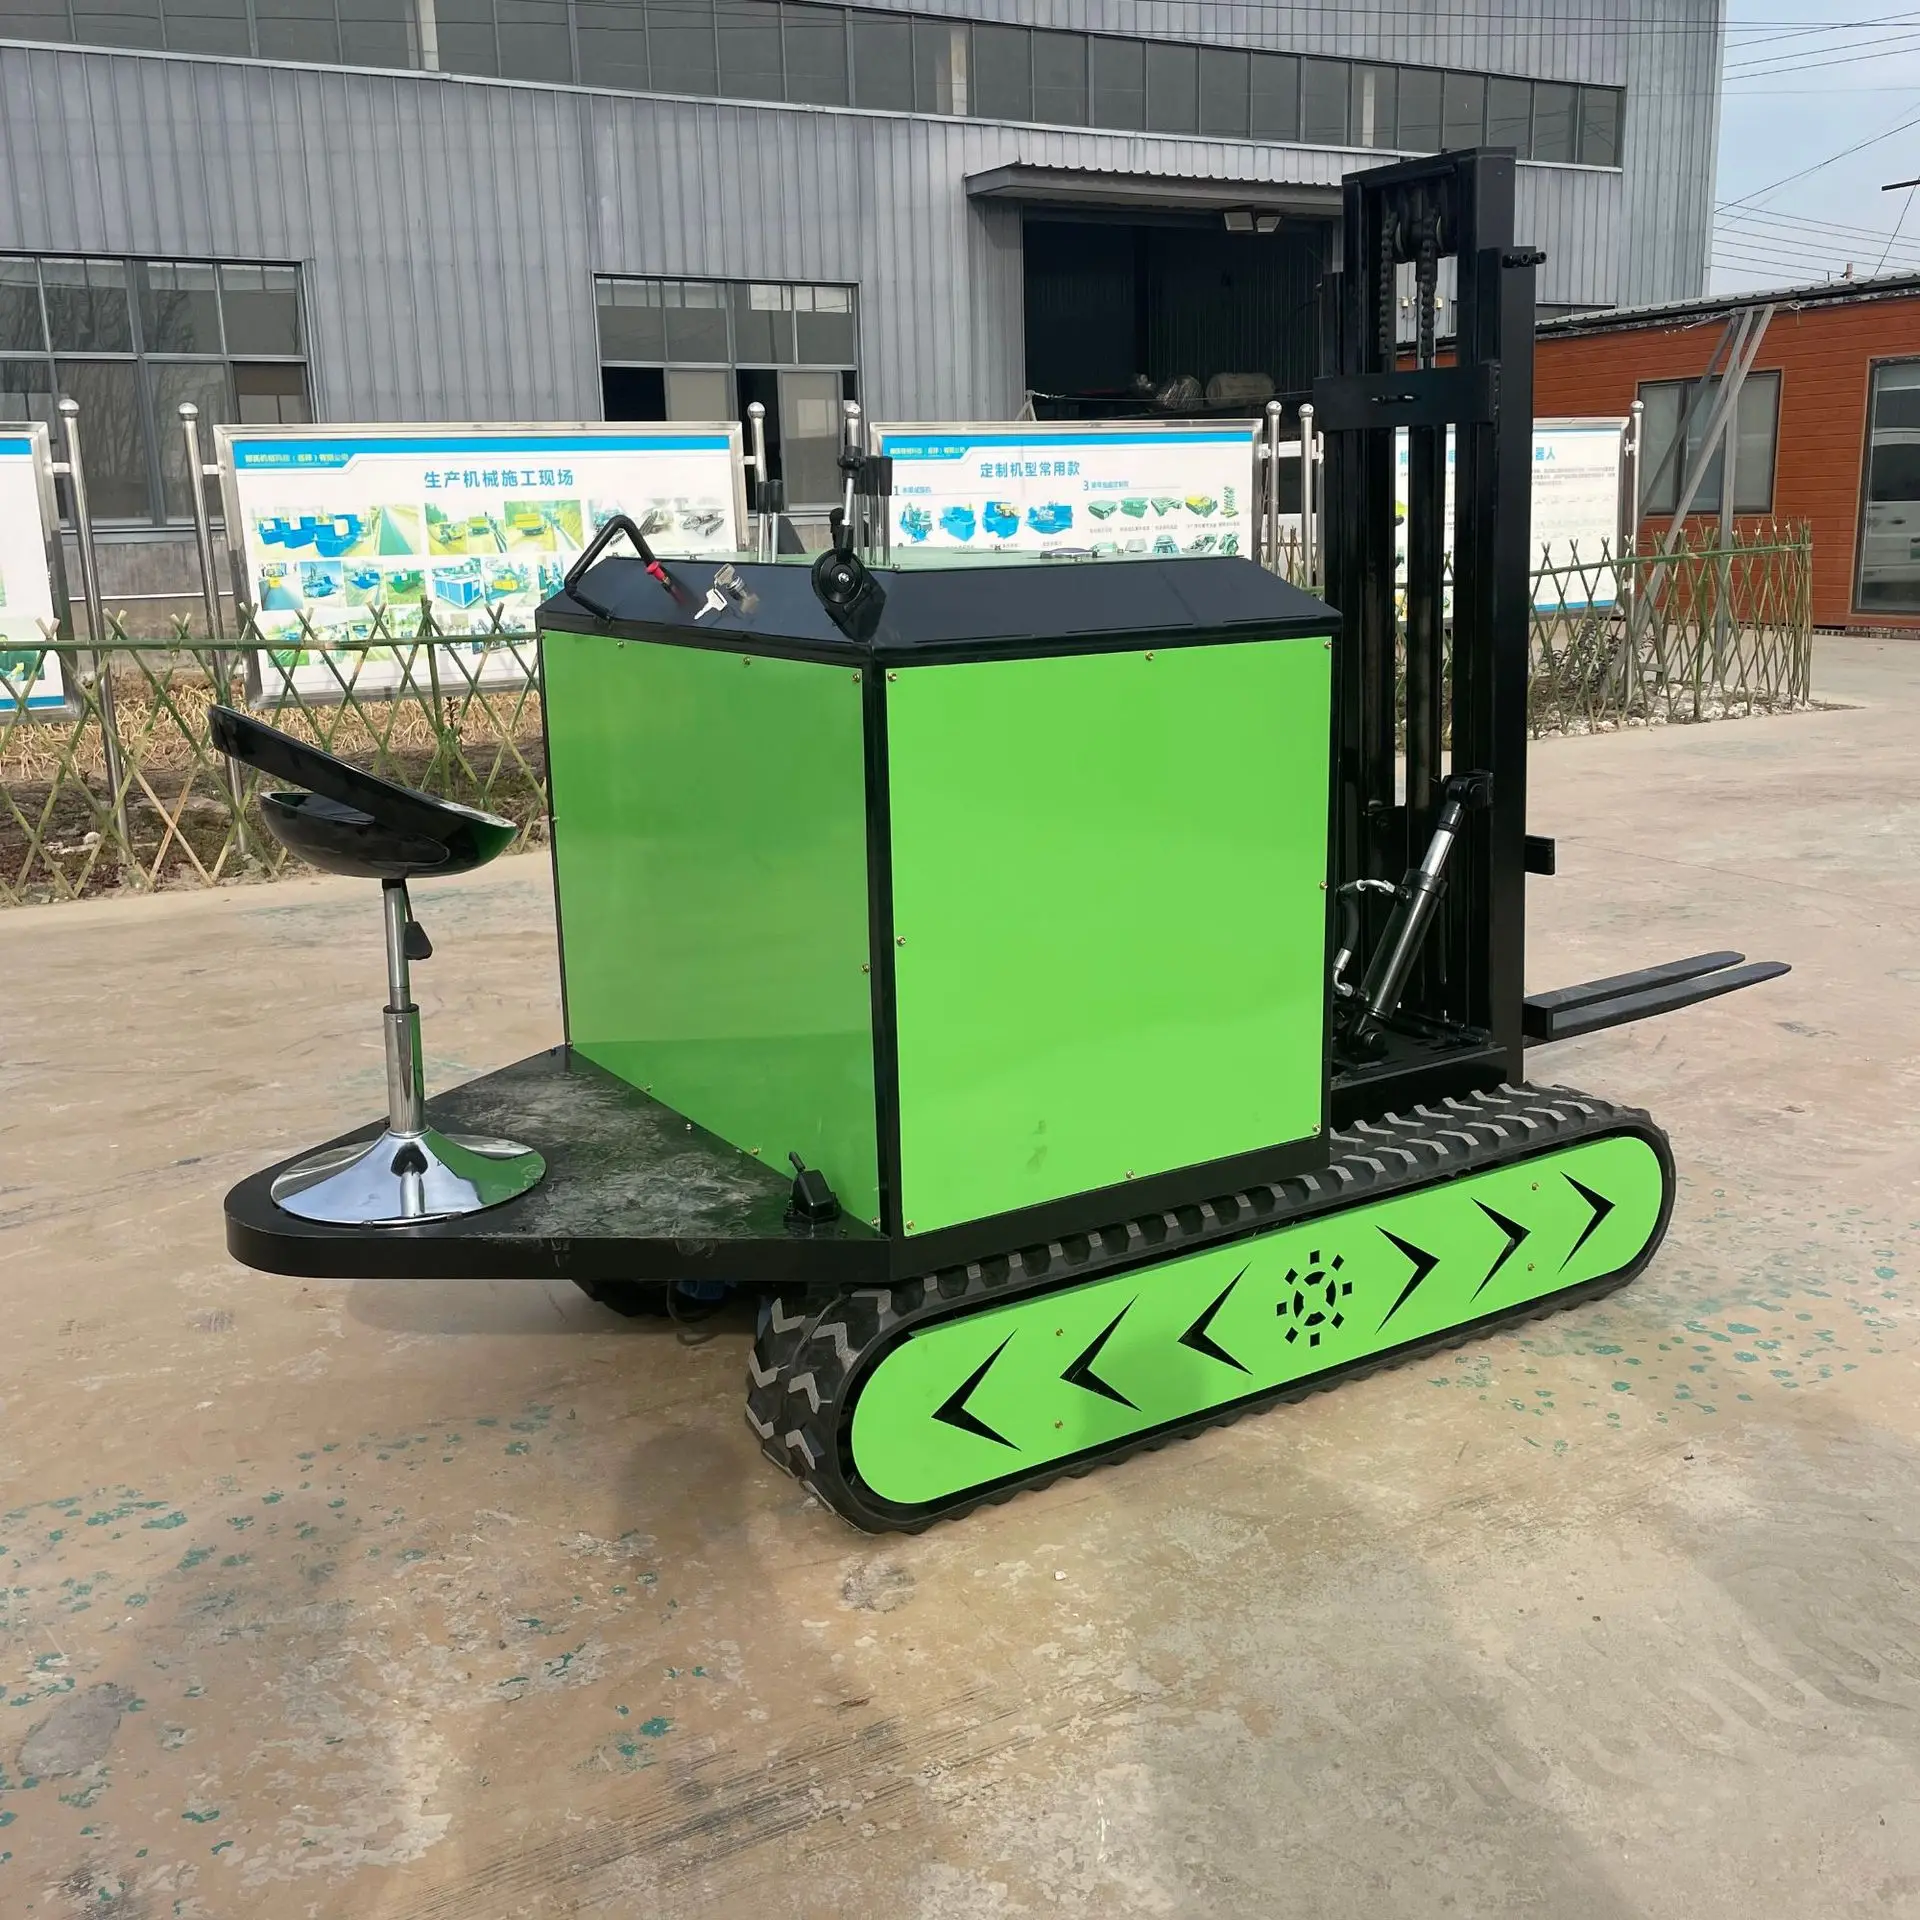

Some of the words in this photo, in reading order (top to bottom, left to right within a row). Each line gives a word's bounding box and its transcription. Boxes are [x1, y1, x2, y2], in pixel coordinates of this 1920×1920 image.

[980, 461, 1080, 478] 定制机型常用款
[424, 469, 574, 488] 生产机械施工现场
[1083, 480, 1090, 491] 3
